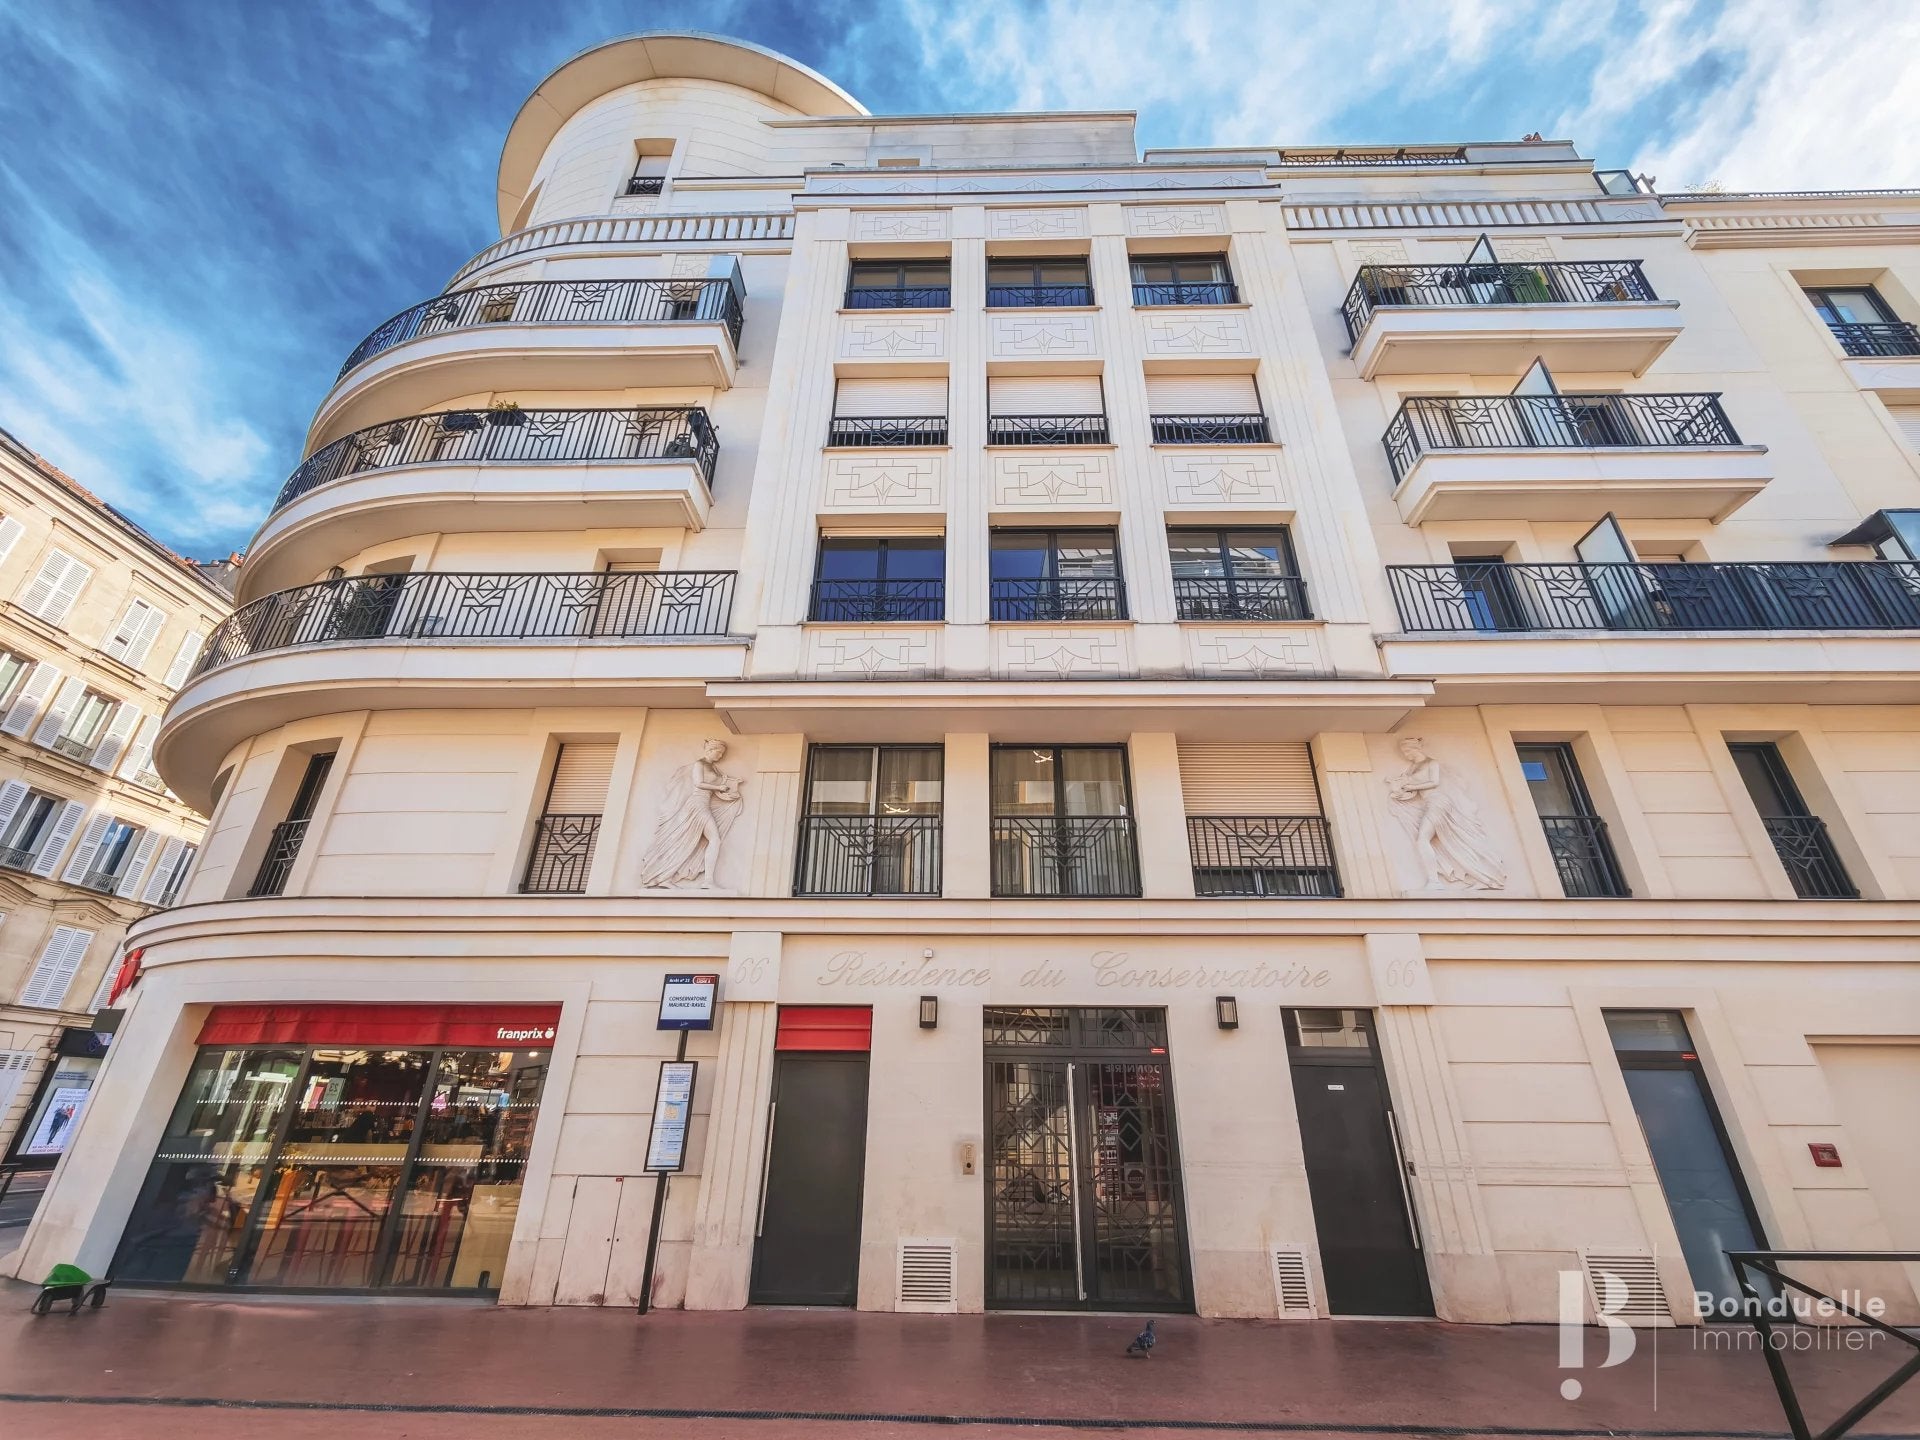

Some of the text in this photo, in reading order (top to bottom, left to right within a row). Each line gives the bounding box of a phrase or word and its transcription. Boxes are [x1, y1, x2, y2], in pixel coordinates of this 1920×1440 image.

[734, 957, 770, 985] 66
[817, 950, 1332, 988] Résidence du Conservatoire
[1386, 959, 1418, 988] 66
[497, 1028, 543, 1041] franprix
